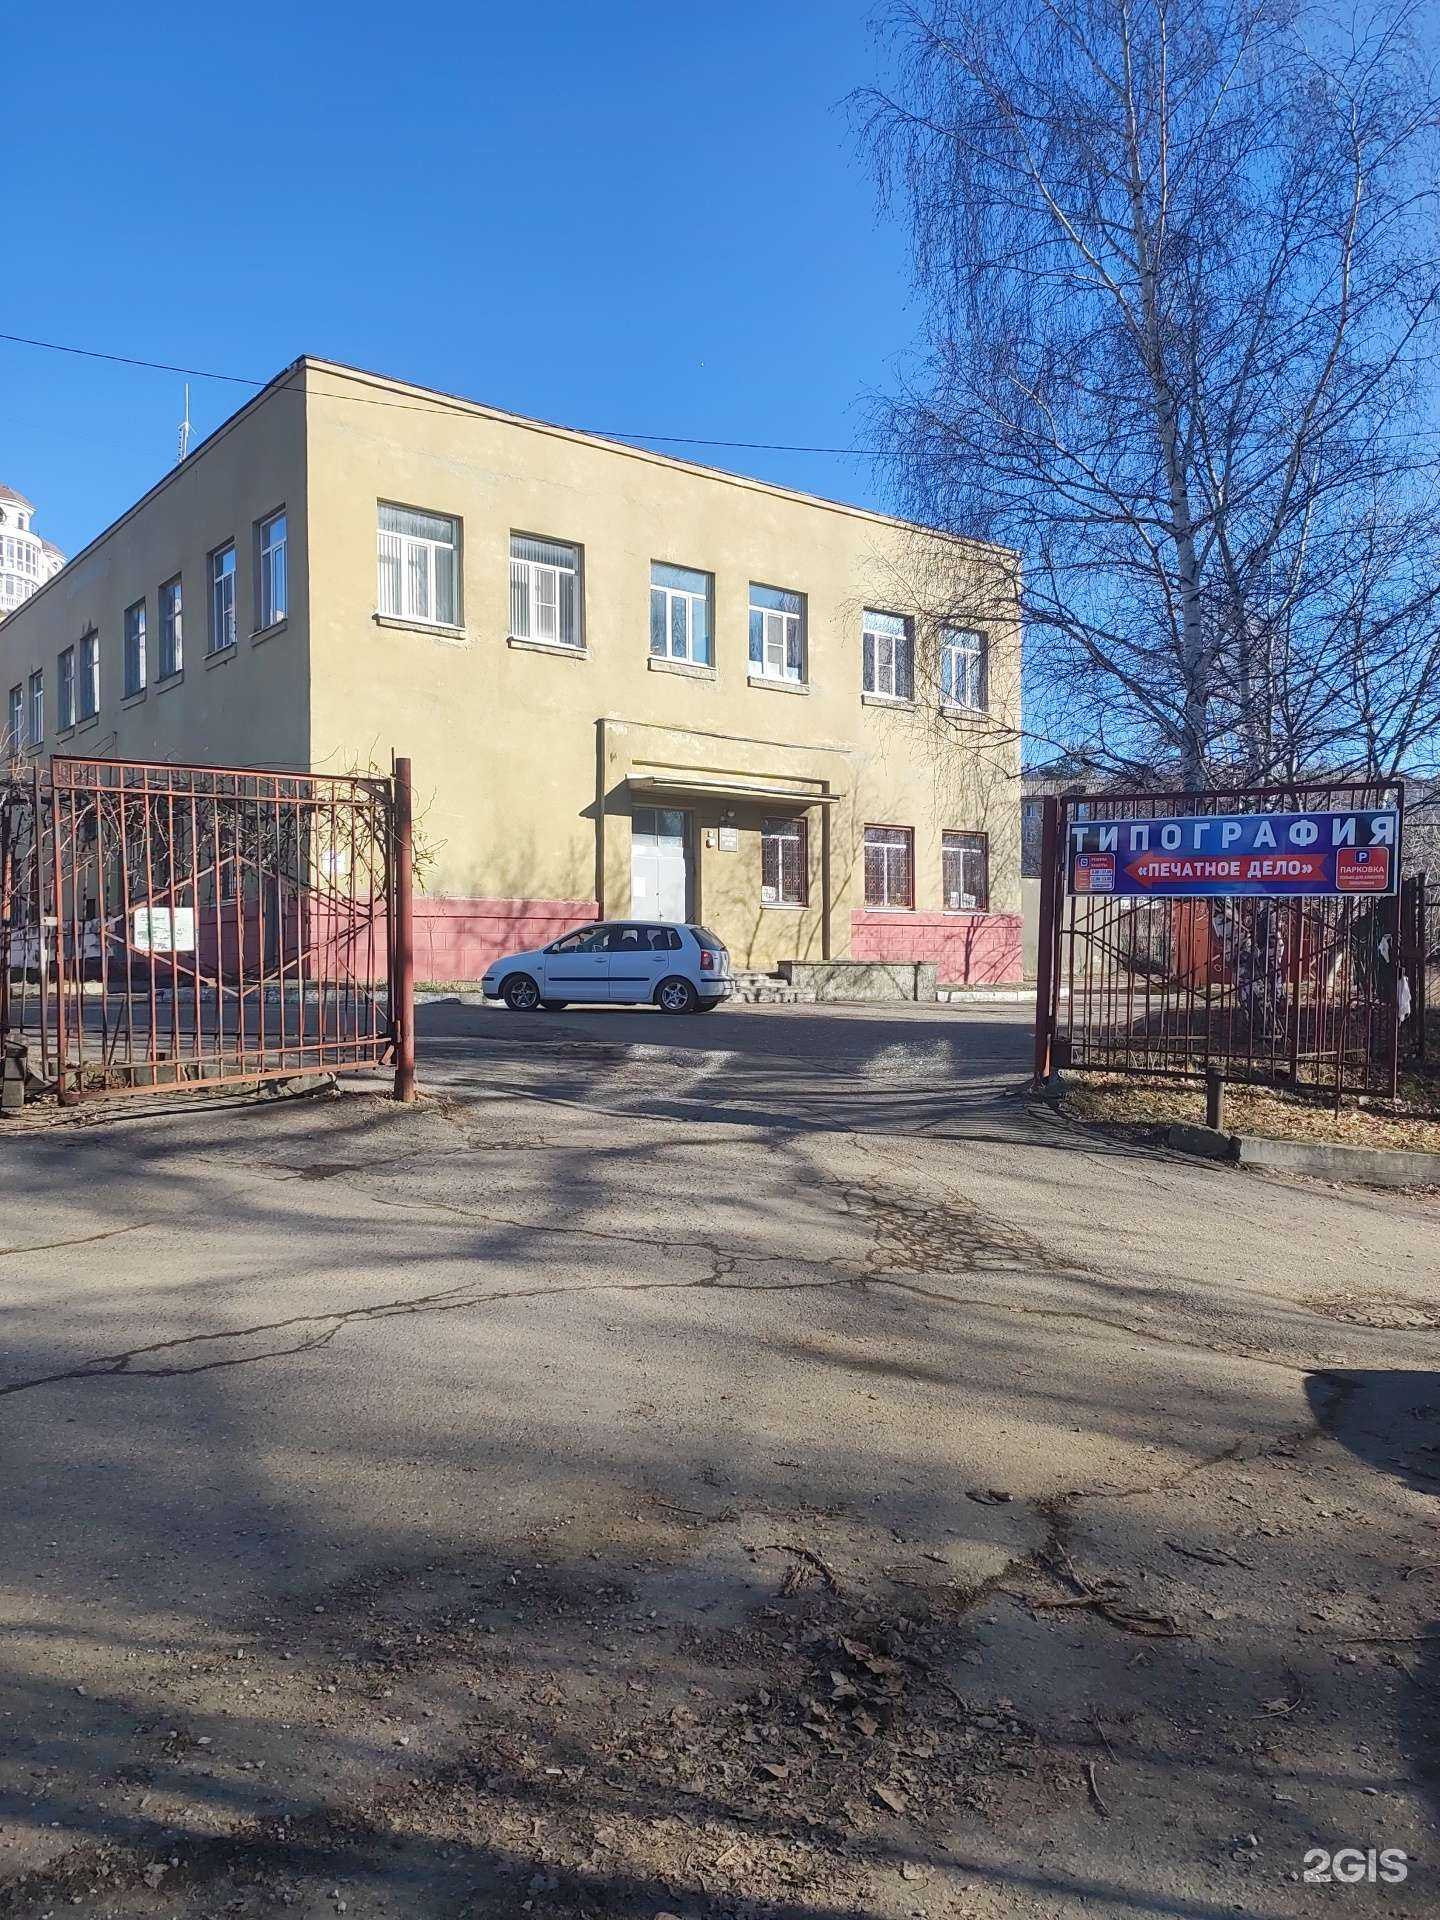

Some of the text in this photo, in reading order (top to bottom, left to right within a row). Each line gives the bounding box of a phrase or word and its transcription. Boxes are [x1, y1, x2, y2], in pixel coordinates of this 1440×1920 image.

[1071, 816, 1395, 852] ТИПОГРАФИЯ
[1137, 860, 1313, 878] «ПЕЧАТНОЕ ДЕЛО»
[1340, 866, 1385, 874] ПАРКОВКА
